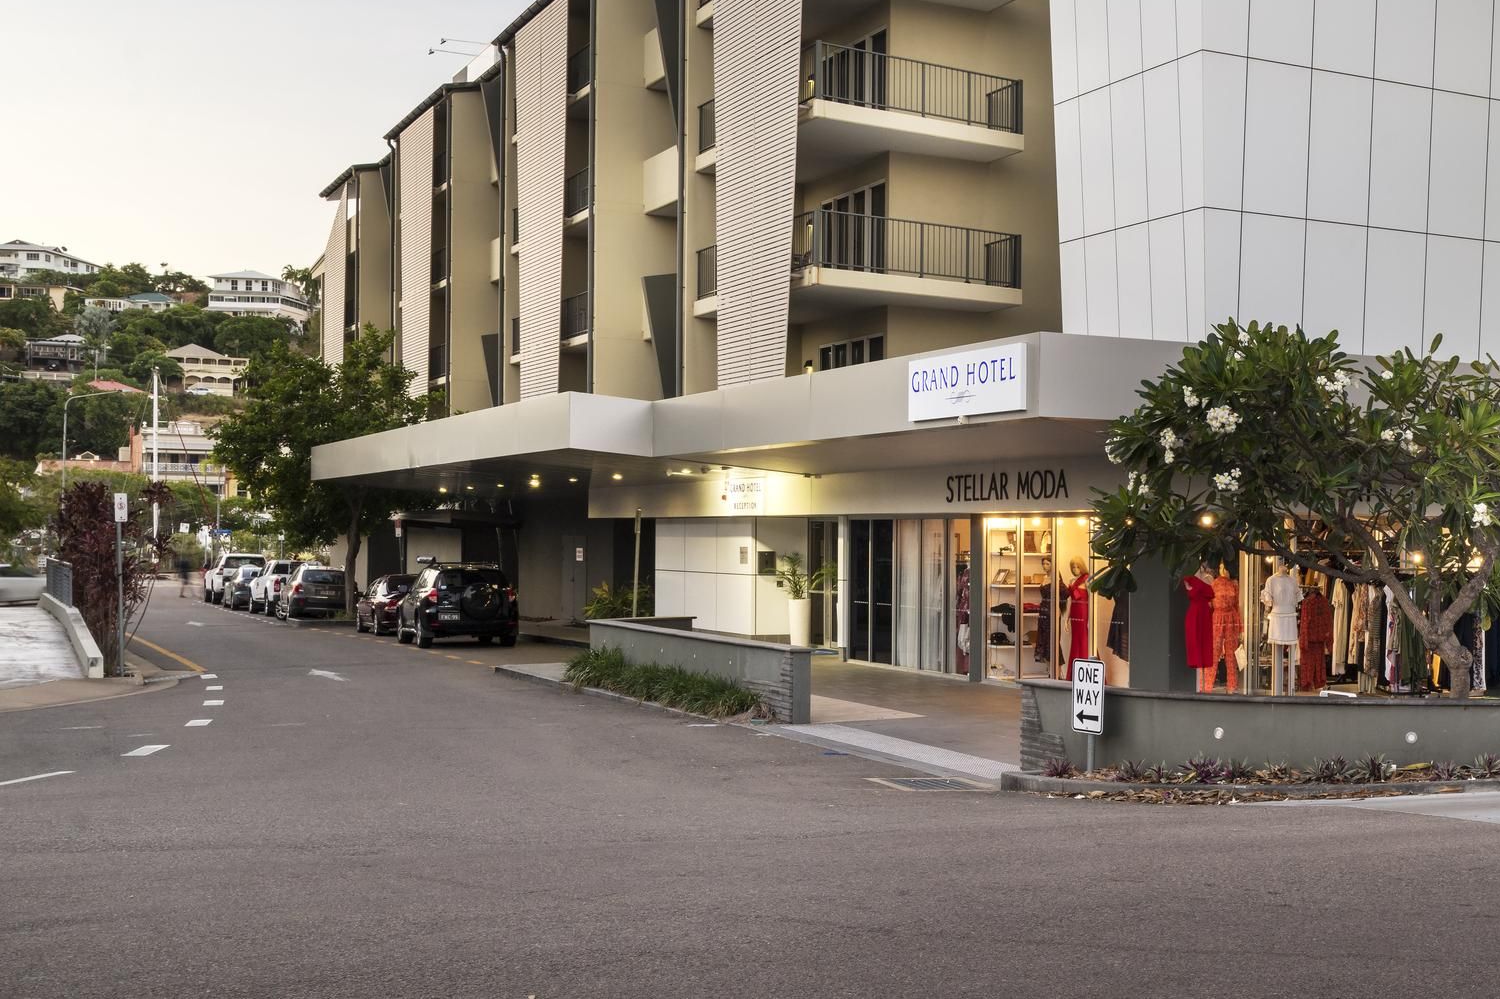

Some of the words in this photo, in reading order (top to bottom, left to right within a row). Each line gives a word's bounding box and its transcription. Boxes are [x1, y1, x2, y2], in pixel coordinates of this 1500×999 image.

[911, 365, 959, 393] GRAND
[966, 357, 1016, 386] HOTEL
[946, 472, 1009, 503] STELLAR
[1016, 468, 1069, 500] MODA
[1078, 666, 1099, 684] ONE
[1076, 688, 1100, 706] WAY
